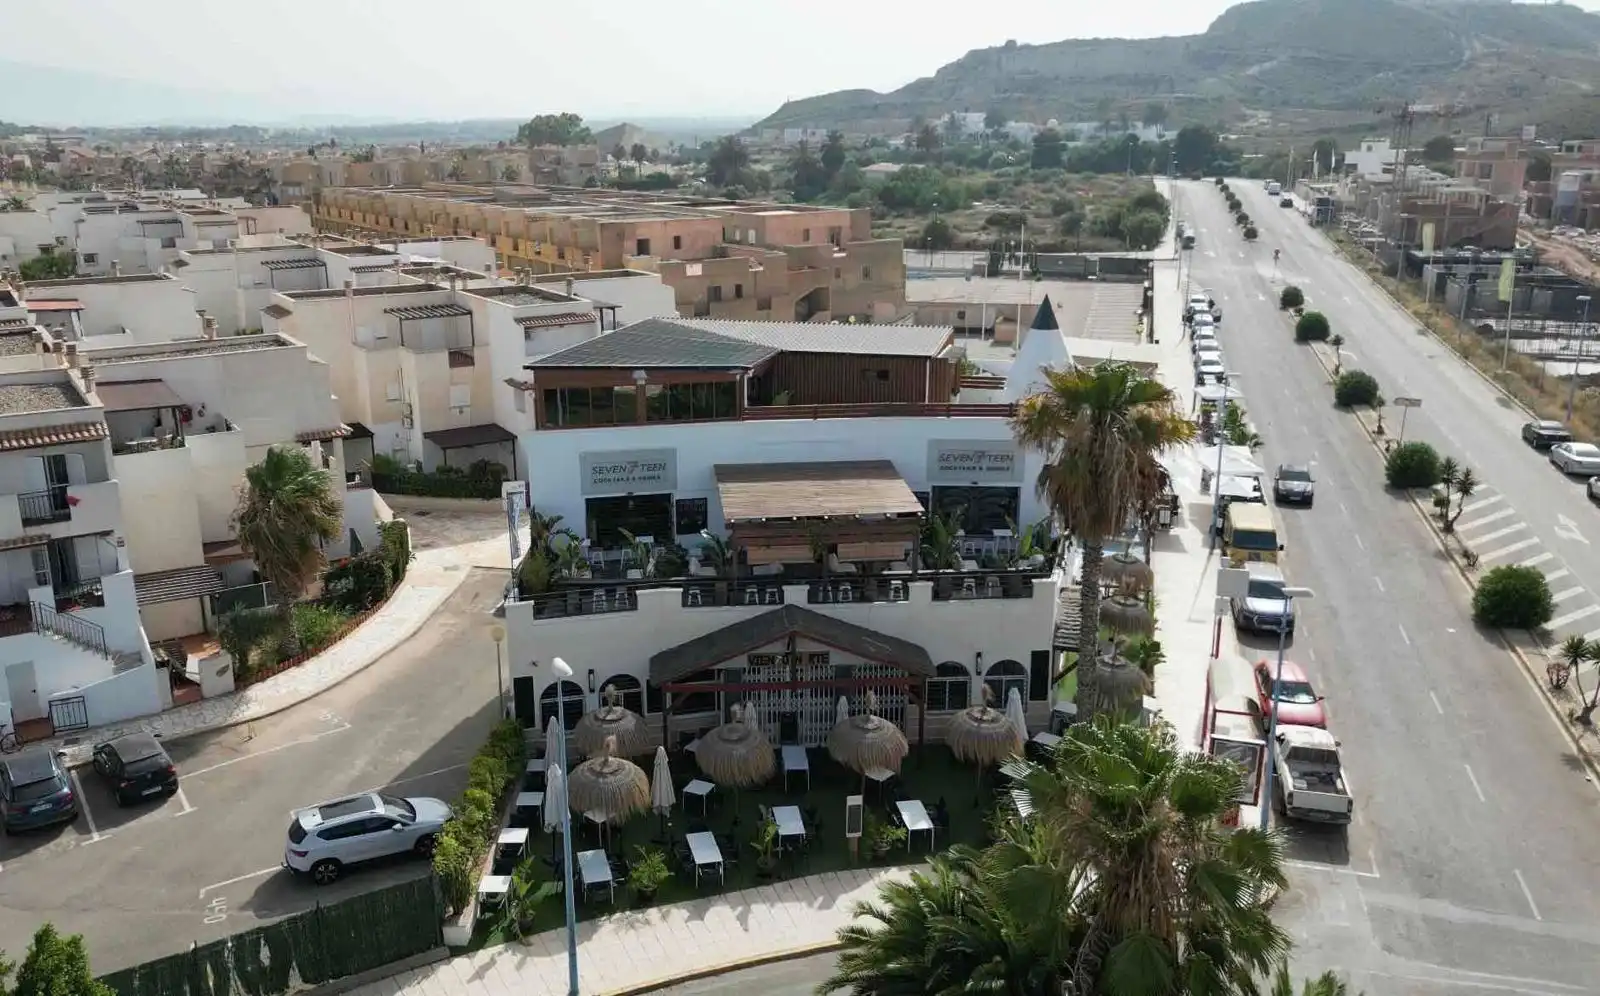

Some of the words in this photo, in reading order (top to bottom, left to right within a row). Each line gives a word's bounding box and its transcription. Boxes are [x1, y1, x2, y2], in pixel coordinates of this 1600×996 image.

[940, 453, 975, 463] SEVEN
[592, 464, 626, 474] SEVEN
[640, 462, 667, 472] TEEN
